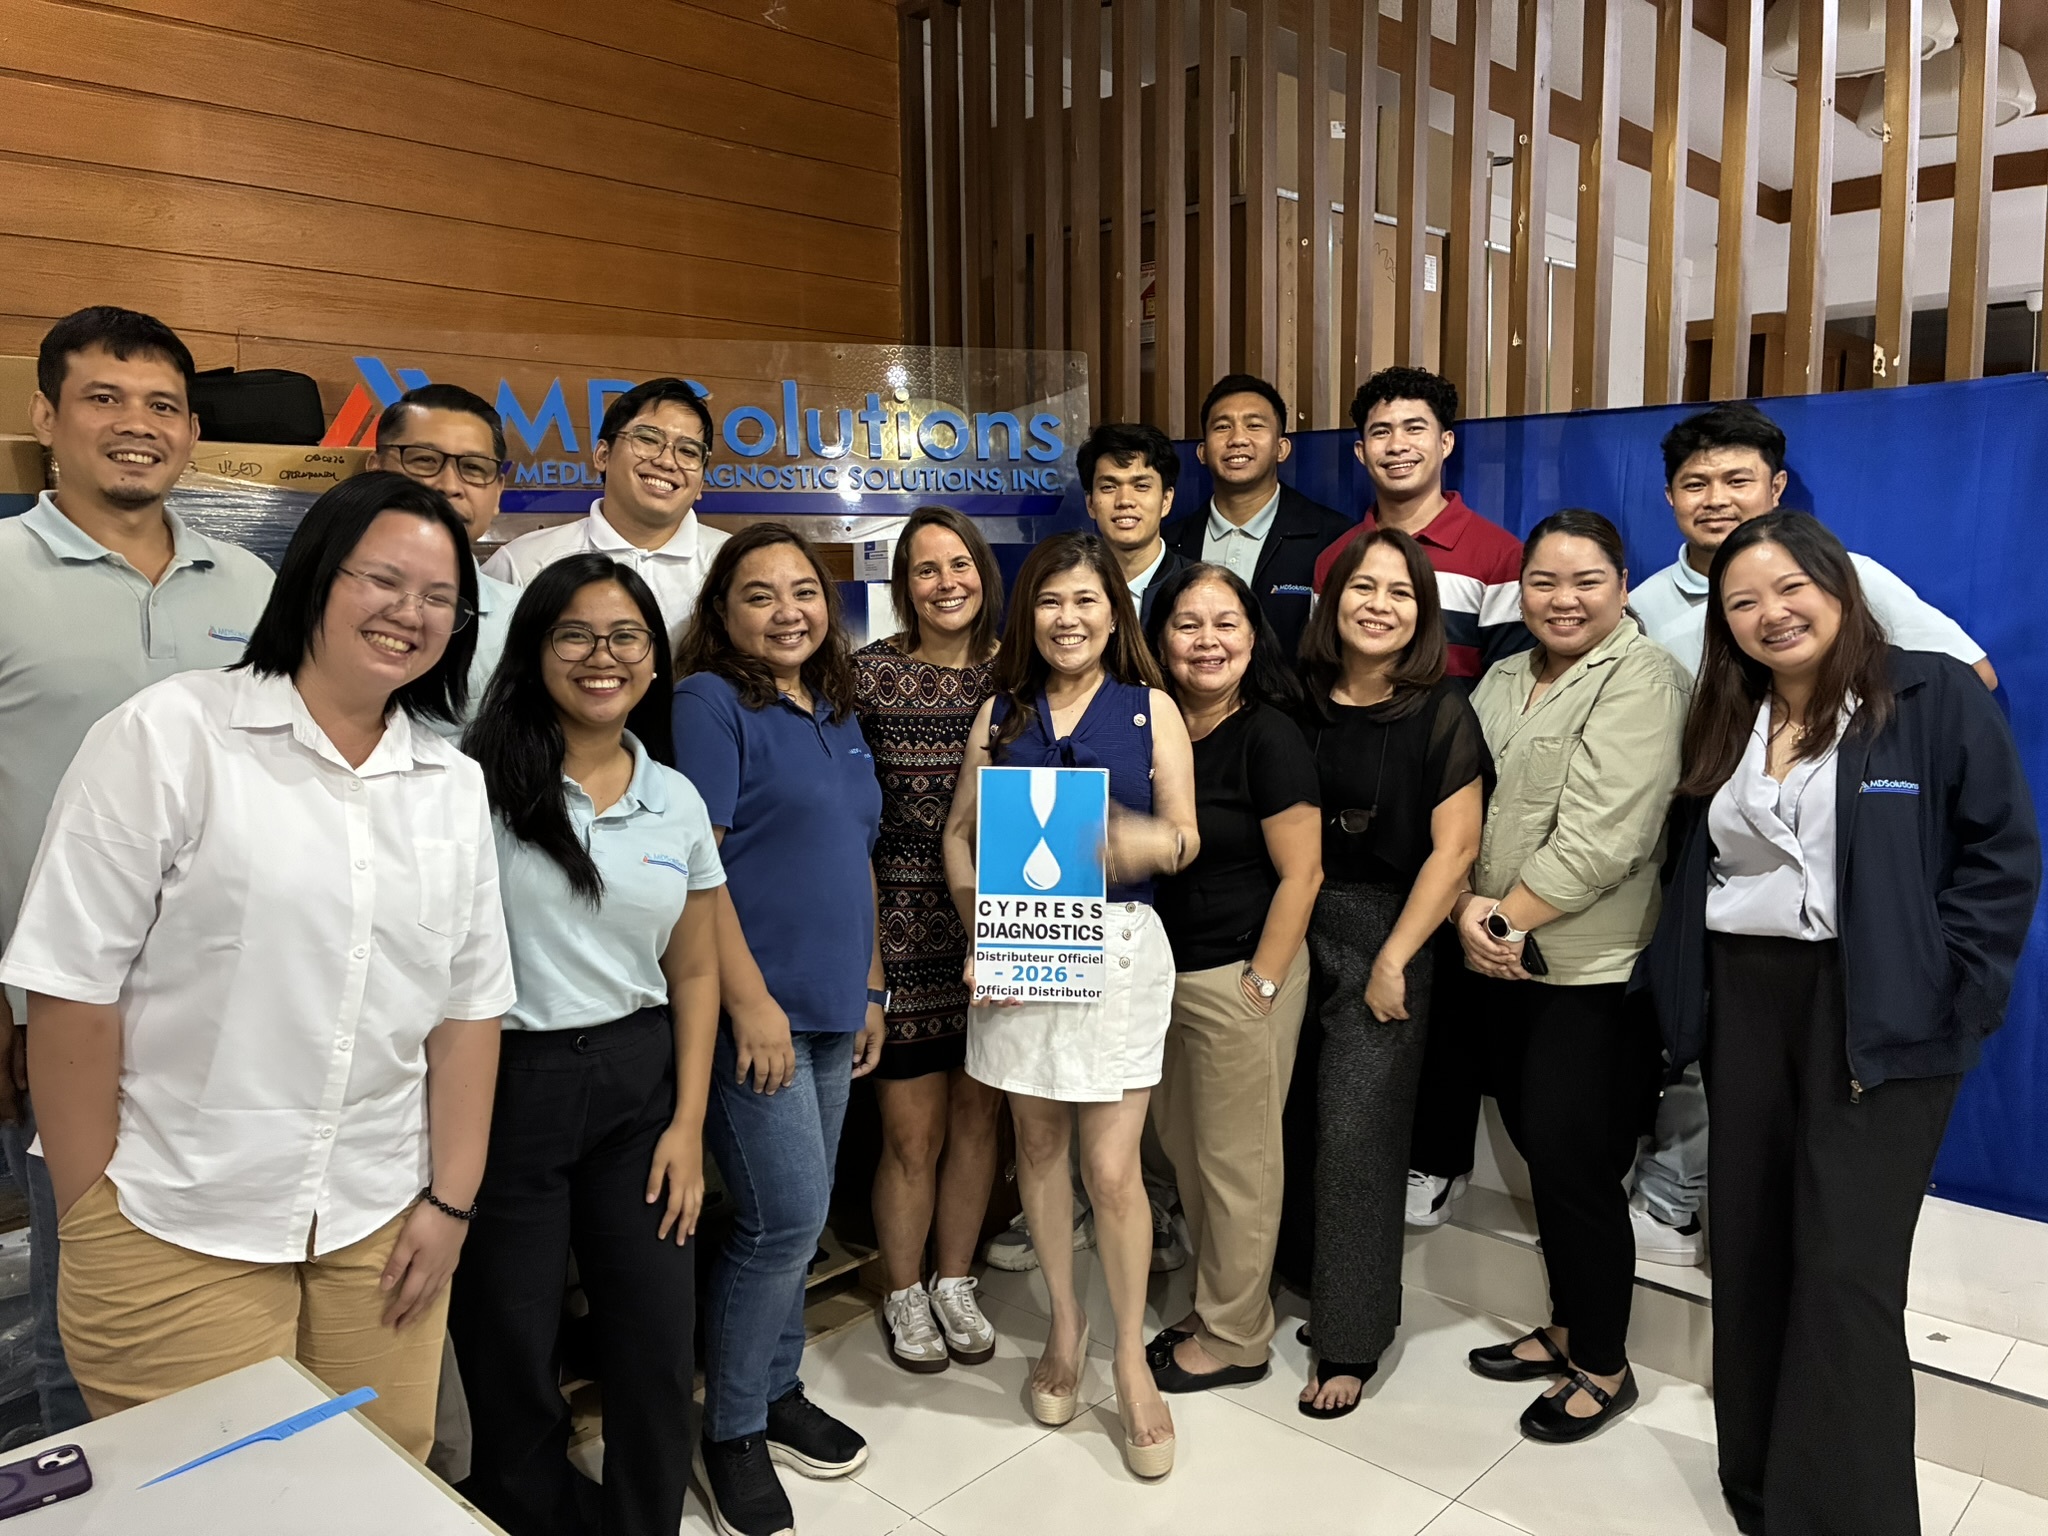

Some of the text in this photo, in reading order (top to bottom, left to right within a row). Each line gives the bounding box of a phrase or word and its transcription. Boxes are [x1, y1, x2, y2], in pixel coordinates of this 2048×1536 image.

[495, 377, 1064, 462] Molutions
[514, 462, 602, 486] MEDL
[704, 464, 838, 491] AGNOSTIC
[850, 466, 1007, 494] SOLUTIONS,
[1869, 779, 1919, 790] MDSolutions
[978, 900, 1103, 919] CYPRESS
[977, 922, 1104, 941] DIAGNOSTICS
[976, 951, 1103, 964] Distributeur Officiel
[1012, 965, 1068, 982] 2026
[976, 985, 1102, 998] Official Distributor
